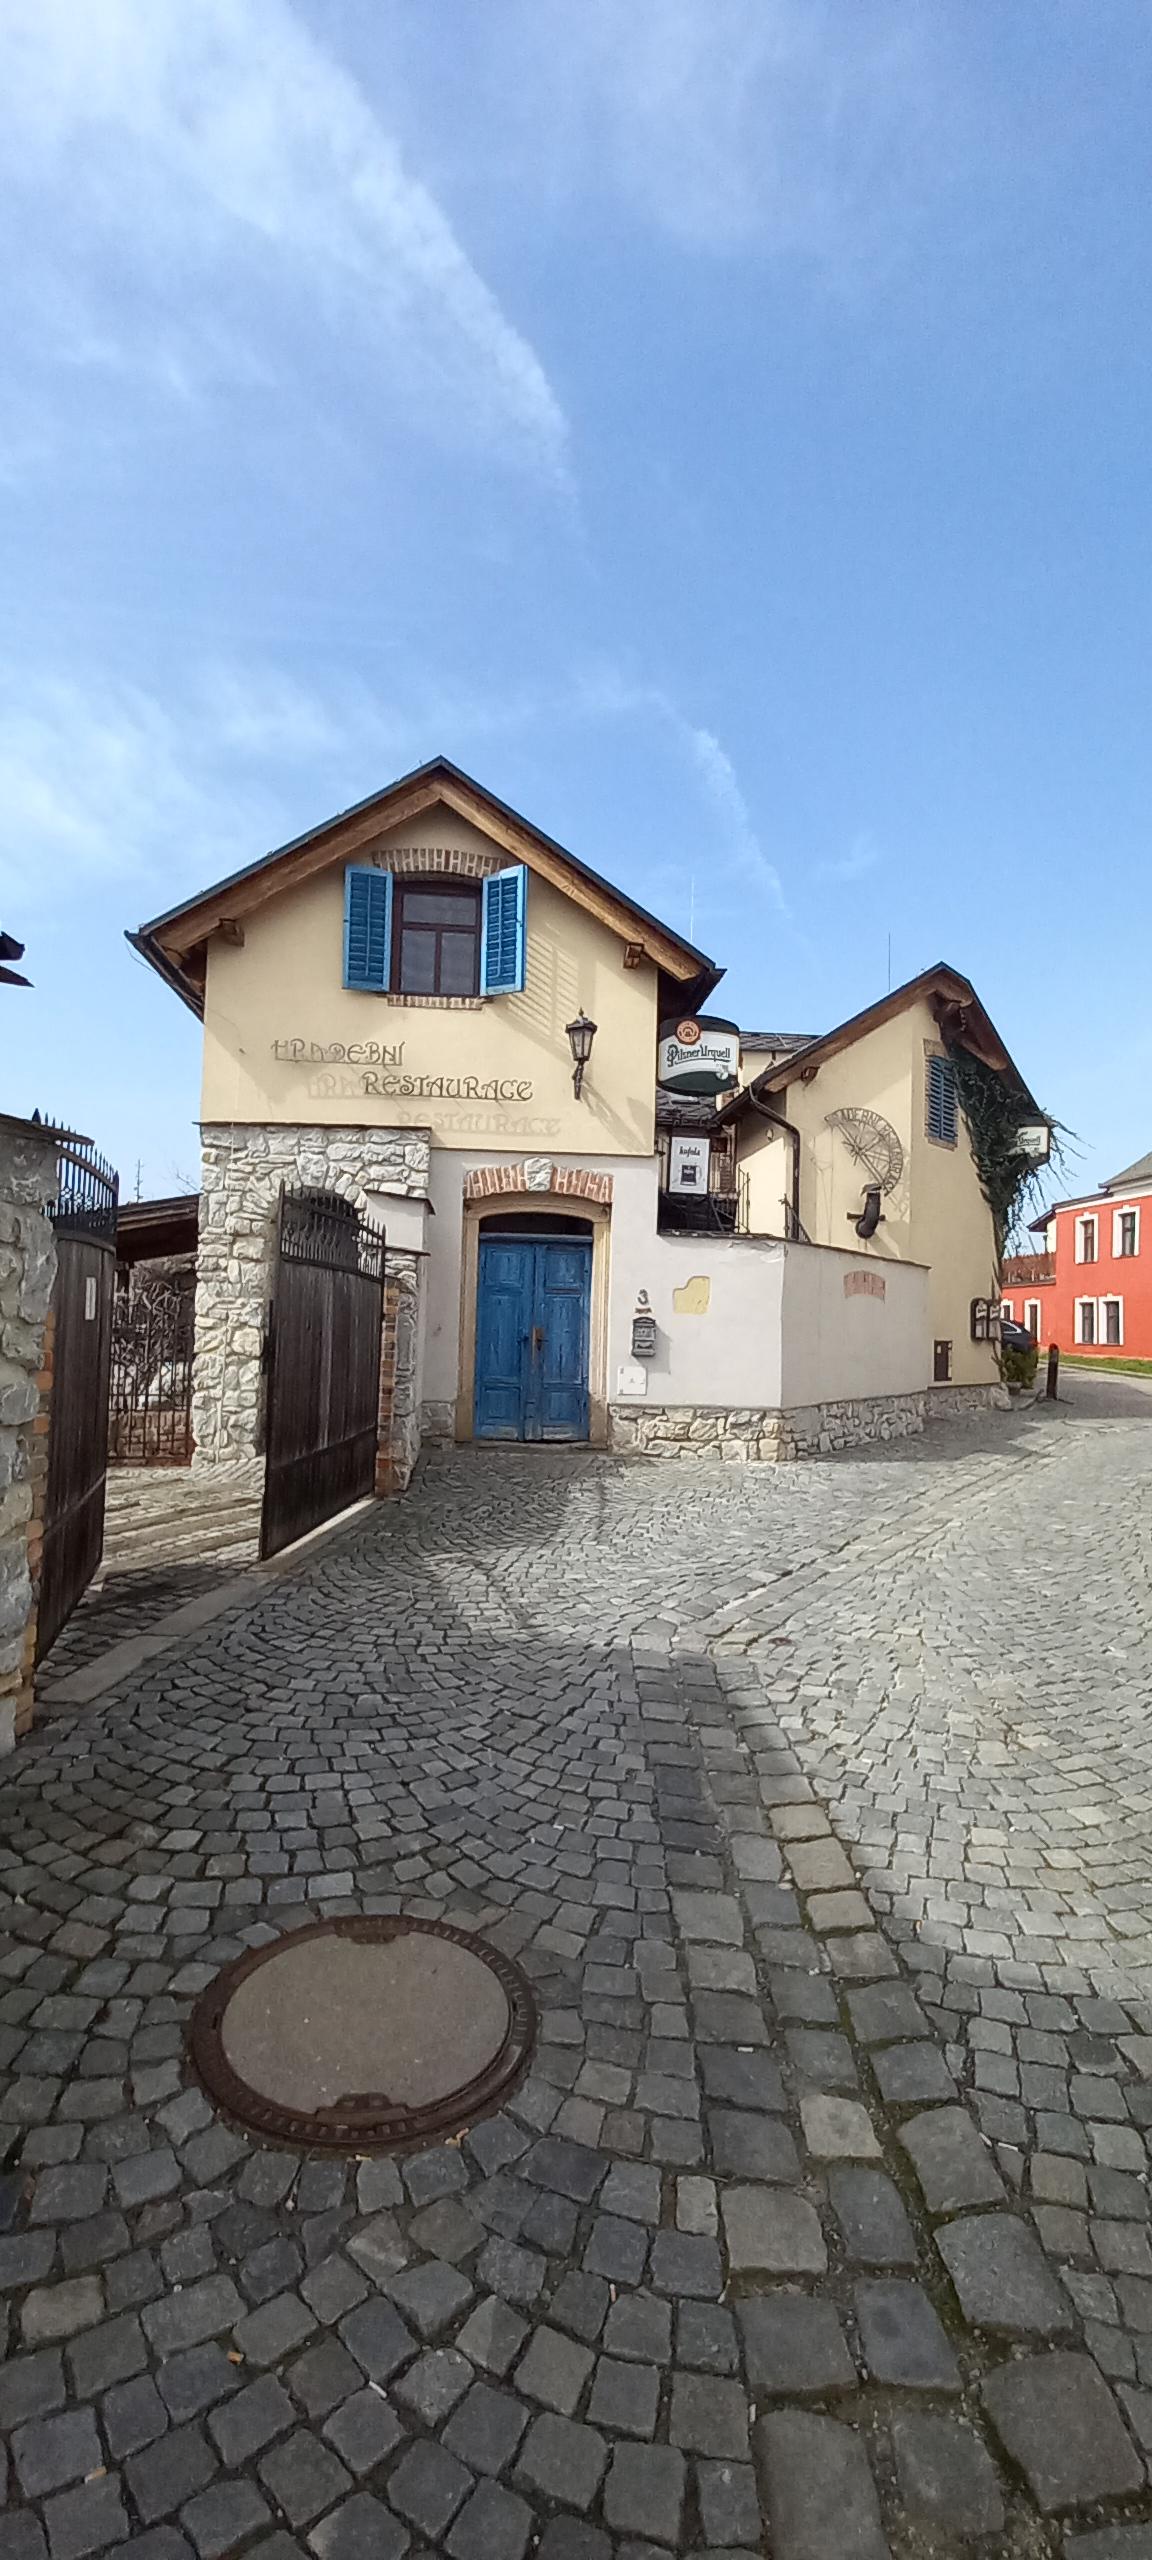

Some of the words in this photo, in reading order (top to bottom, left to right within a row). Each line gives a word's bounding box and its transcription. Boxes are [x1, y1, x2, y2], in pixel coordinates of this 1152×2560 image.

[667, 1044, 700, 1067] Pilsner
[700, 1044, 731, 1062] Urquell
[362, 1071, 533, 1101] RESTAURACE
[637, 1289, 649, 1305] 3
